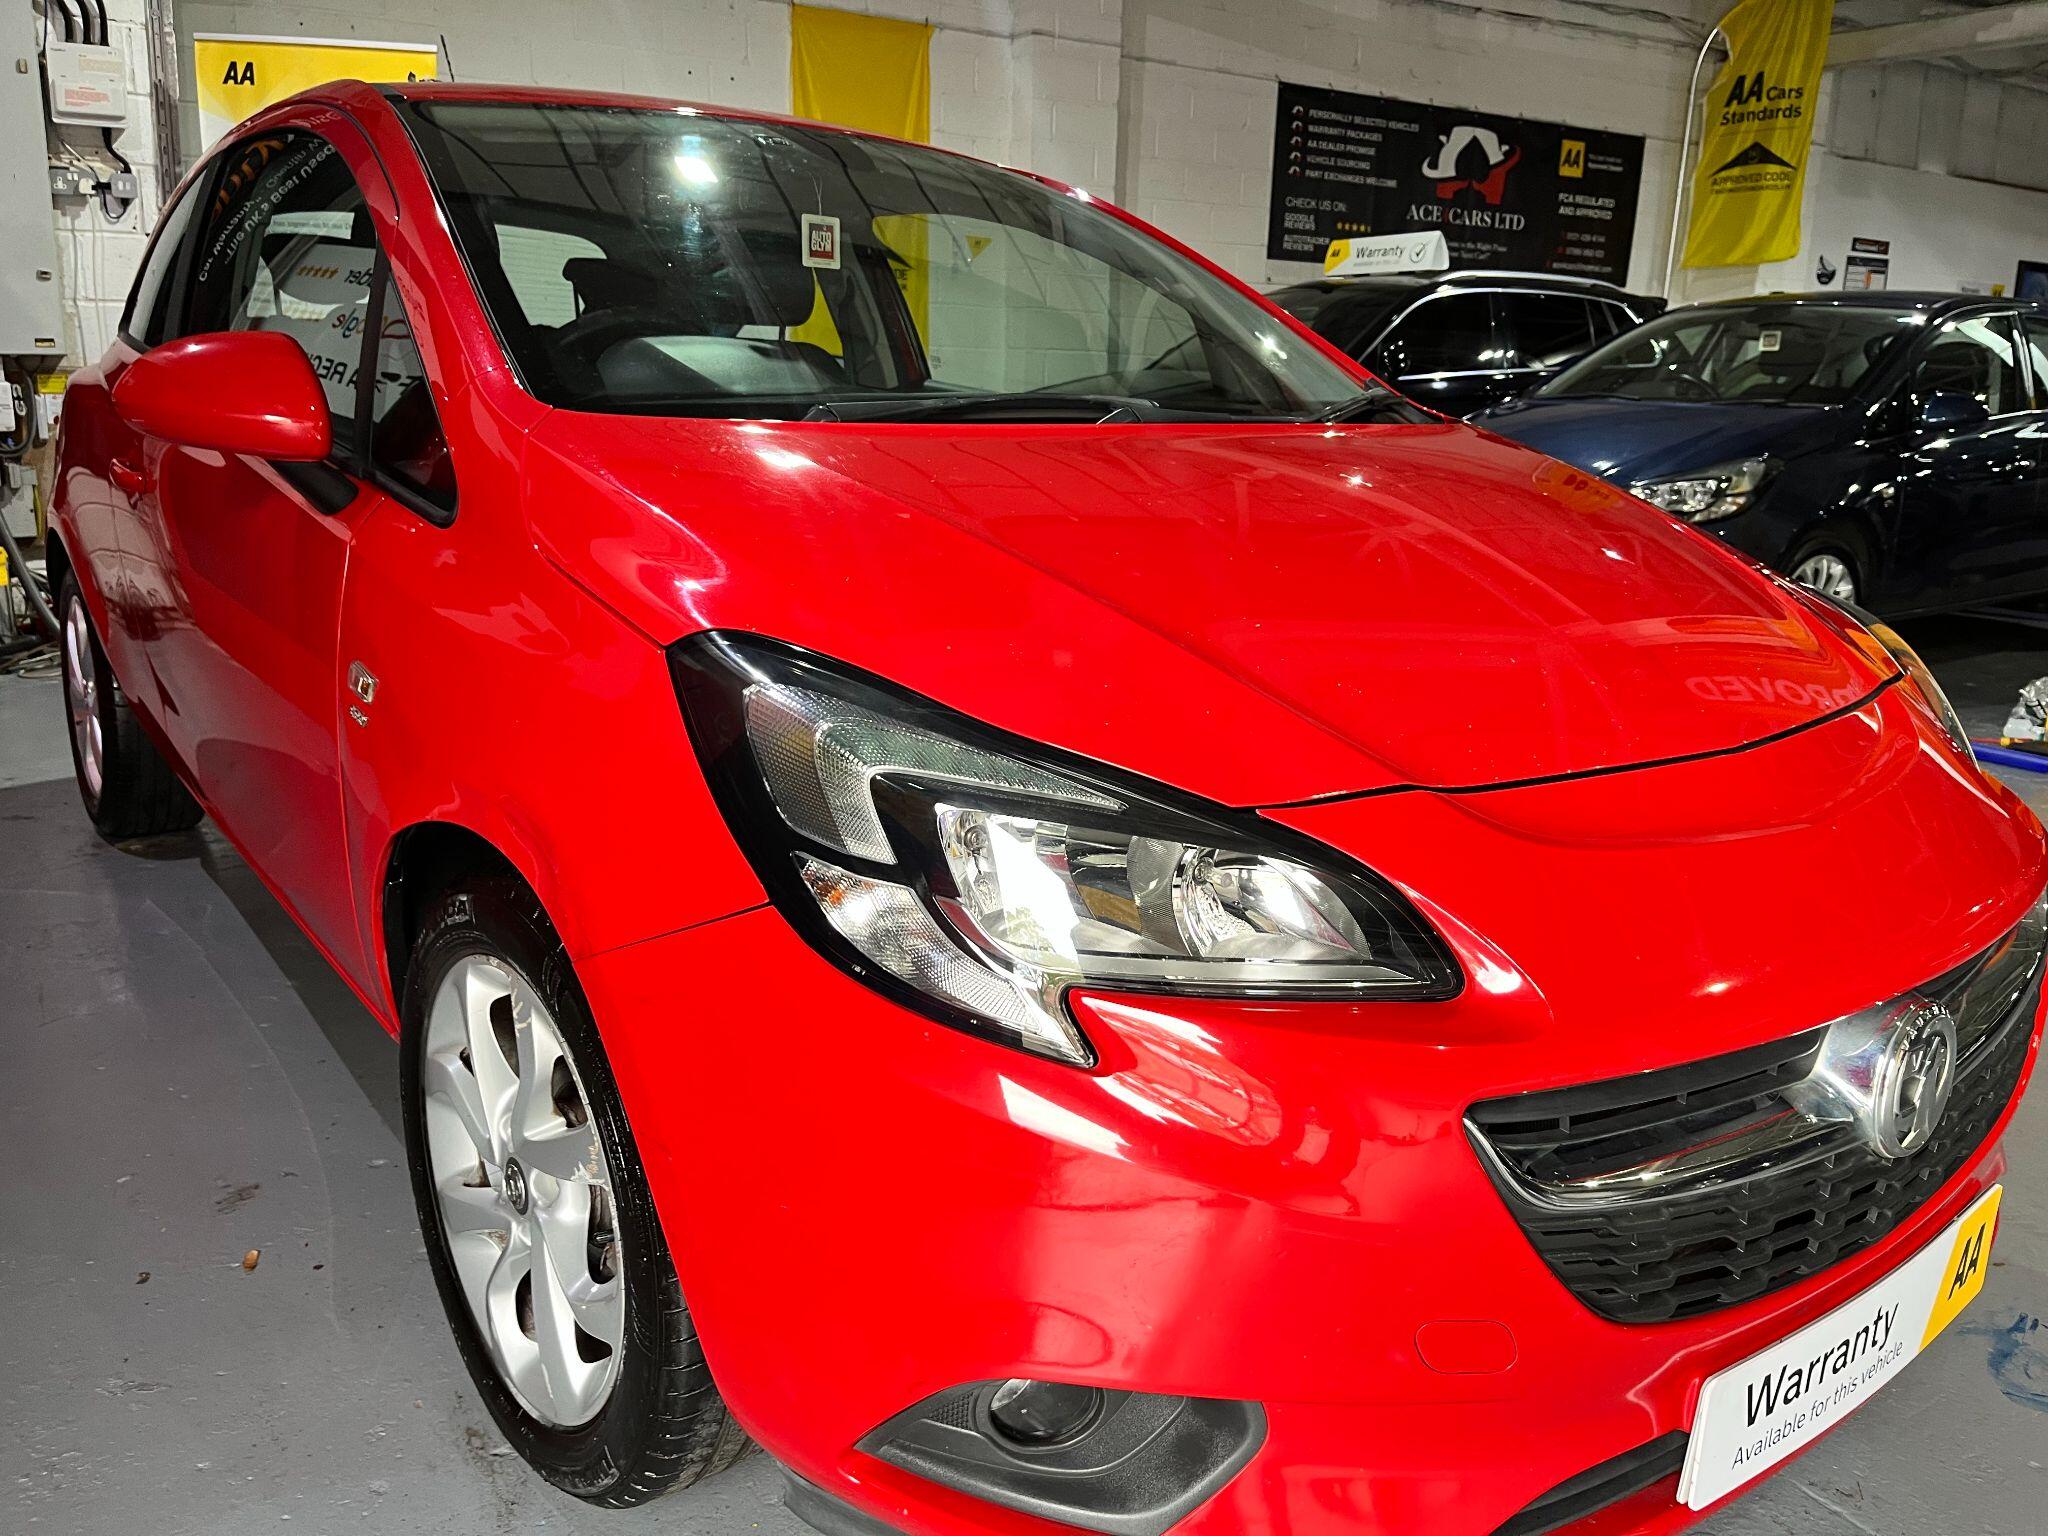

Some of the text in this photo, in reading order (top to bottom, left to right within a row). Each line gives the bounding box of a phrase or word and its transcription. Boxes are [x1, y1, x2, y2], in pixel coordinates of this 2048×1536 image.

[222, 61, 256, 86] AA
[1724, 71, 1804, 108] AA Cars
[1308, 108, 1420, 133] PERSONALLY SELECTED VEHICLES
[1720, 104, 1802, 126] Standards
[1308, 124, 1383, 142] WARRANTY PACKAGES
[1307, 139, 1376, 155] AA DEALER PROMISE
[1306, 154, 1335, 166] VEHICLE
[1562, 148, 1580, 168] AA
[1305, 169, 1323, 179] PART
[1285, 196, 1317, 209] CHECK
[1318, 200, 1331, 210] US
[1406, 204, 1526, 231] ACE CARS LTD
[811, 230, 832, 242] AUTO
[1356, 245, 1405, 259] Warranty
[1947, 1222, 1986, 1300] AA
[1746, 1302, 1900, 1428] Warranty
[1732, 1339, 1904, 1470] Available for this vehicle
